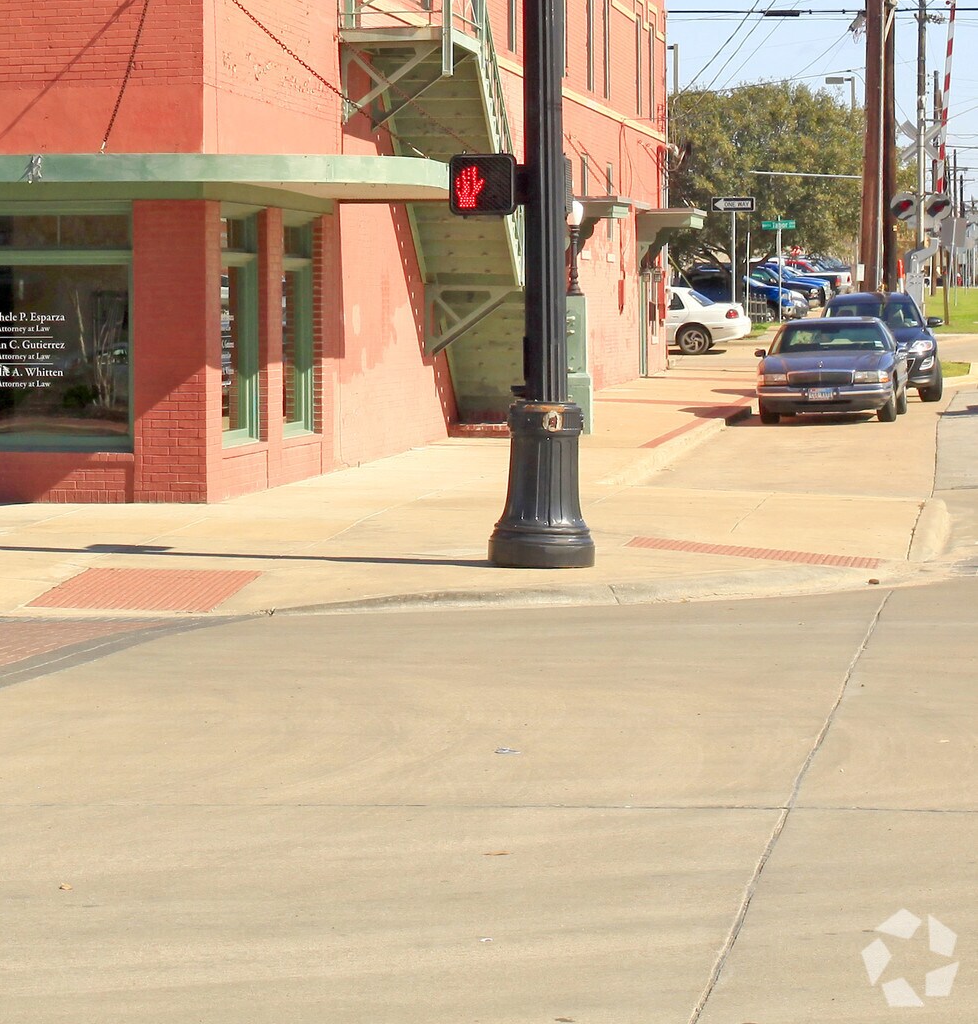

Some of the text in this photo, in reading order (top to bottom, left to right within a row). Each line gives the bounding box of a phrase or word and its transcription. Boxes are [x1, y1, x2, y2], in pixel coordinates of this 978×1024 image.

[19, 312, 28, 322] P.
[30, 312, 65, 324] Esparza
[9, 340, 20, 349] C.
[22, 340, 65, 349] Gutierrez
[36, 352, 51, 360] Law
[12, 368, 23, 377] A.
[25, 367, 64, 377] Whitten
[36, 380, 51, 388] Law
